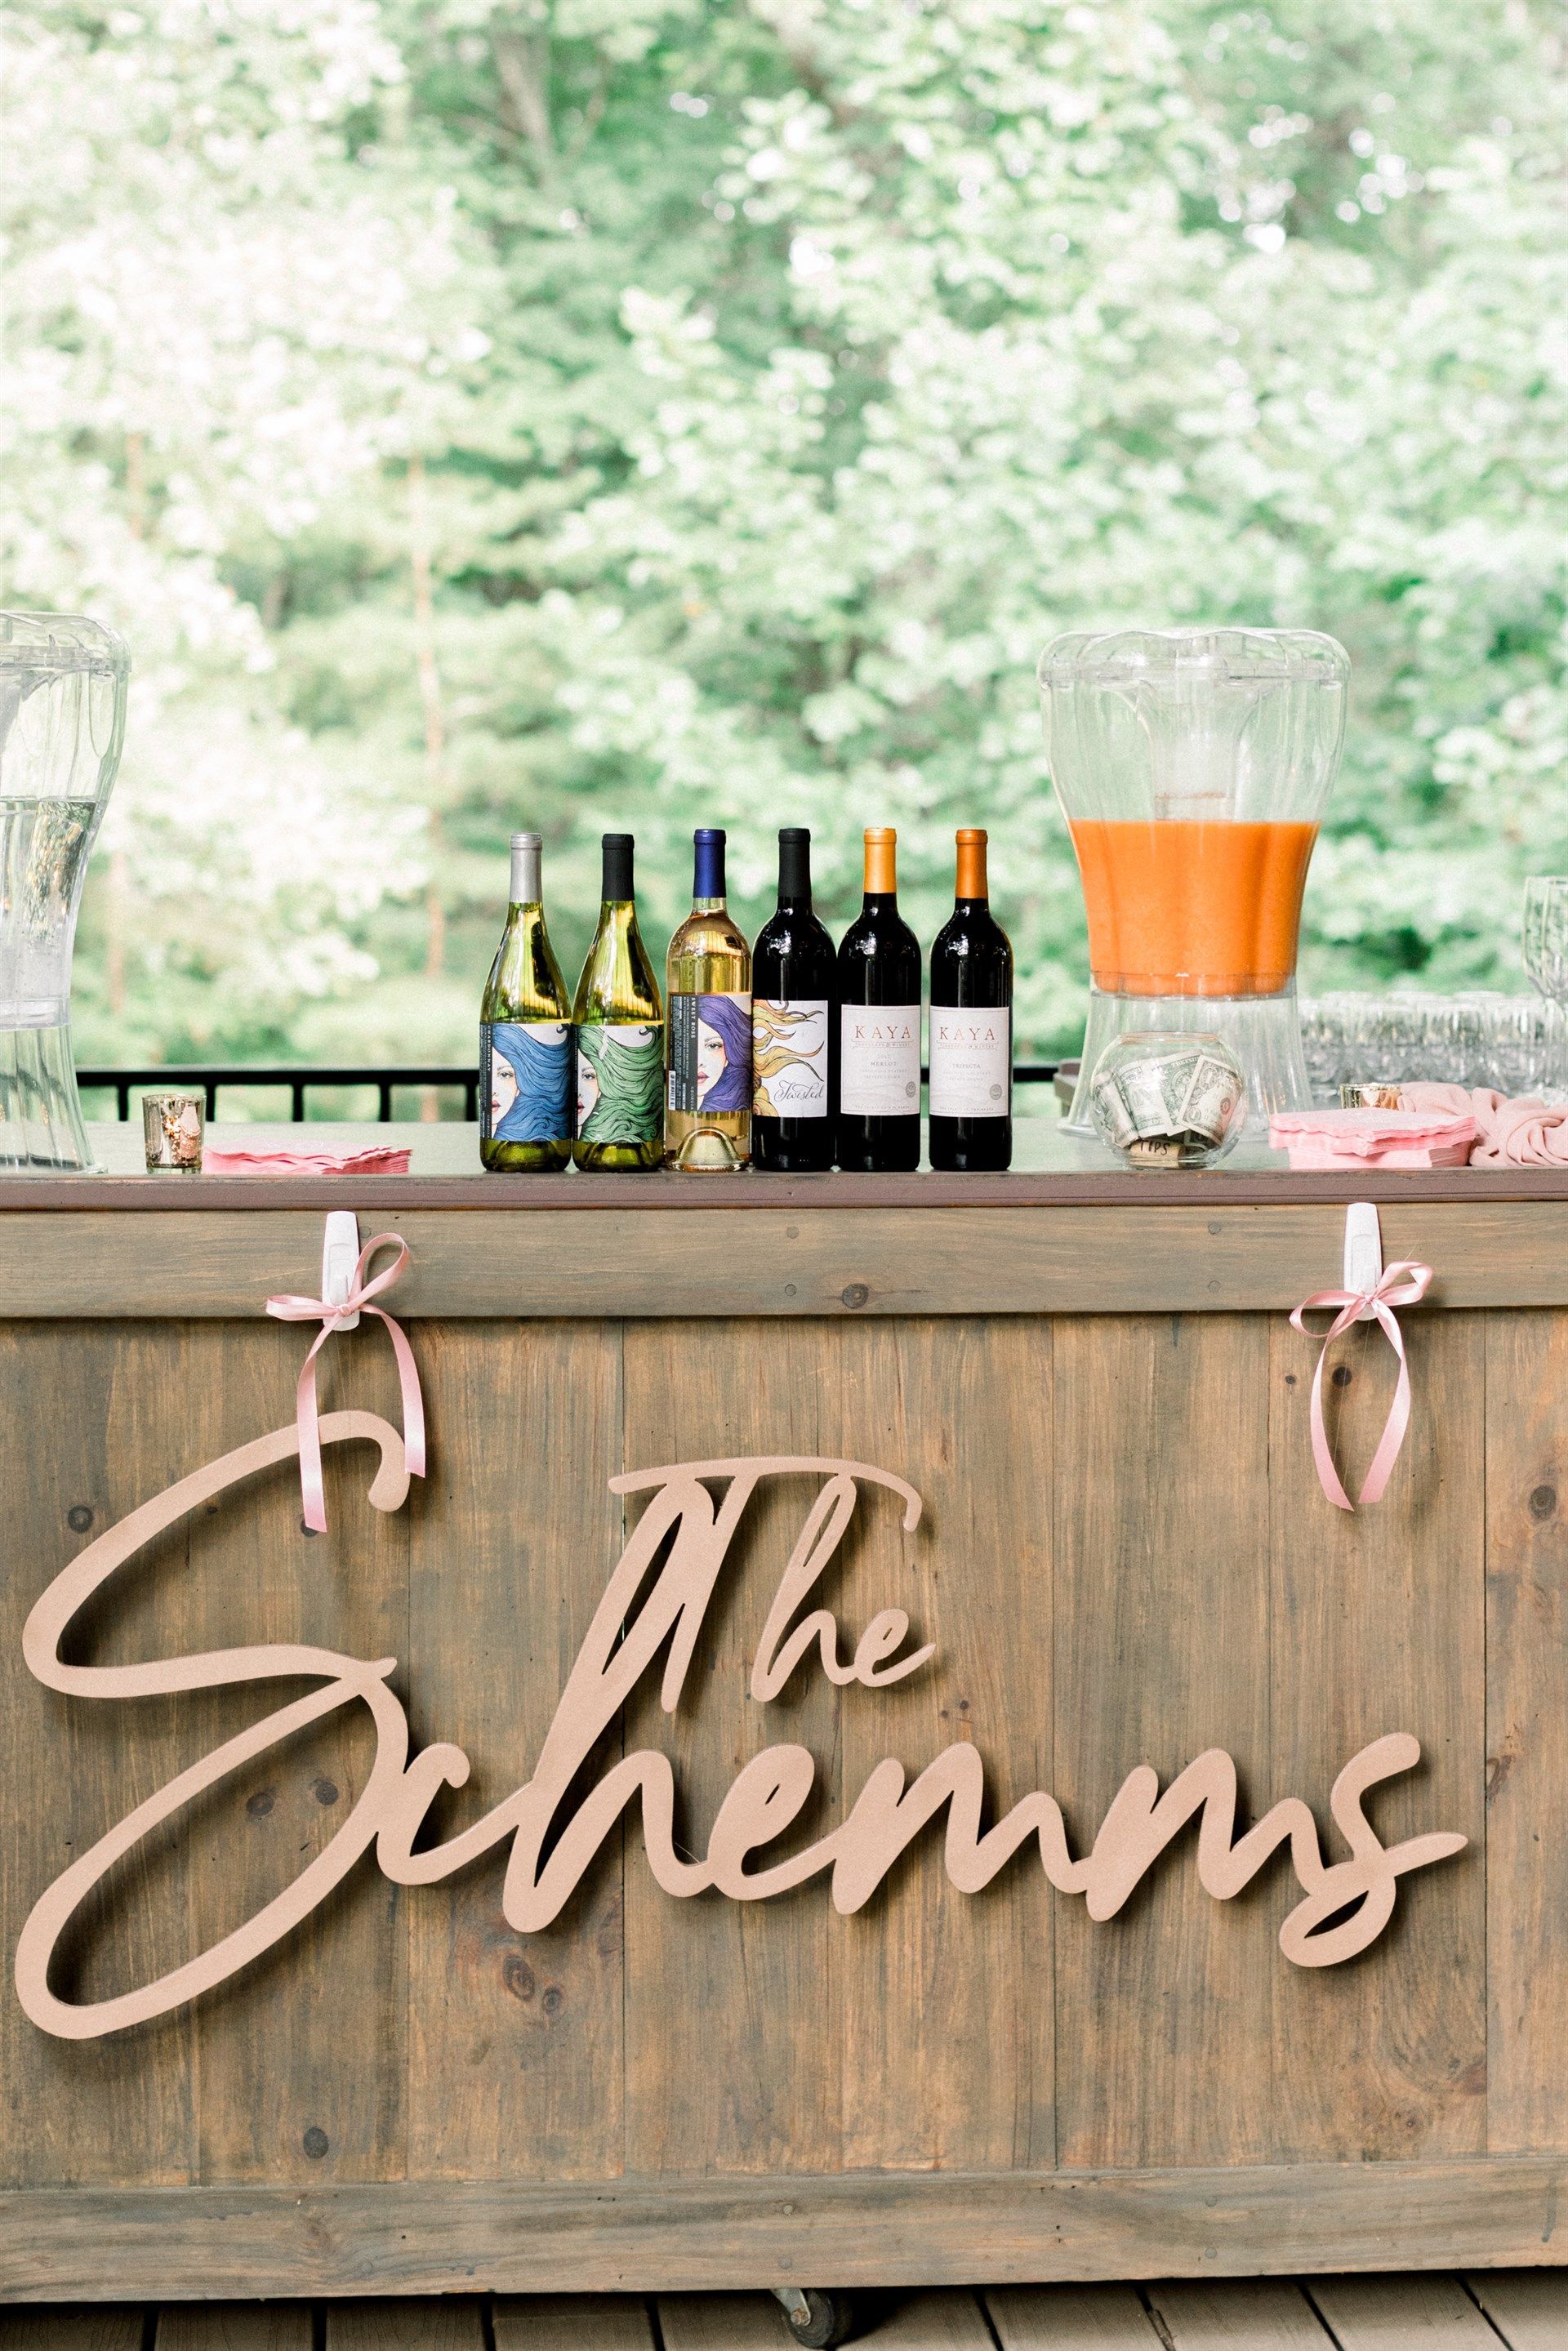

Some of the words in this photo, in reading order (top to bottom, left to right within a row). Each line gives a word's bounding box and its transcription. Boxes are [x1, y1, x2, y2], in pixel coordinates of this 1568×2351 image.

[855, 1025, 911, 1040] KAYA
[939, 1026, 995, 1040] KAYA
[774, 1080, 825, 1102] Twisted
[1138, 1139, 1170, 1156] TIPS
[608, 1455, 936, 1713] The
[16, 1411, 1468, 2039] Schemms
